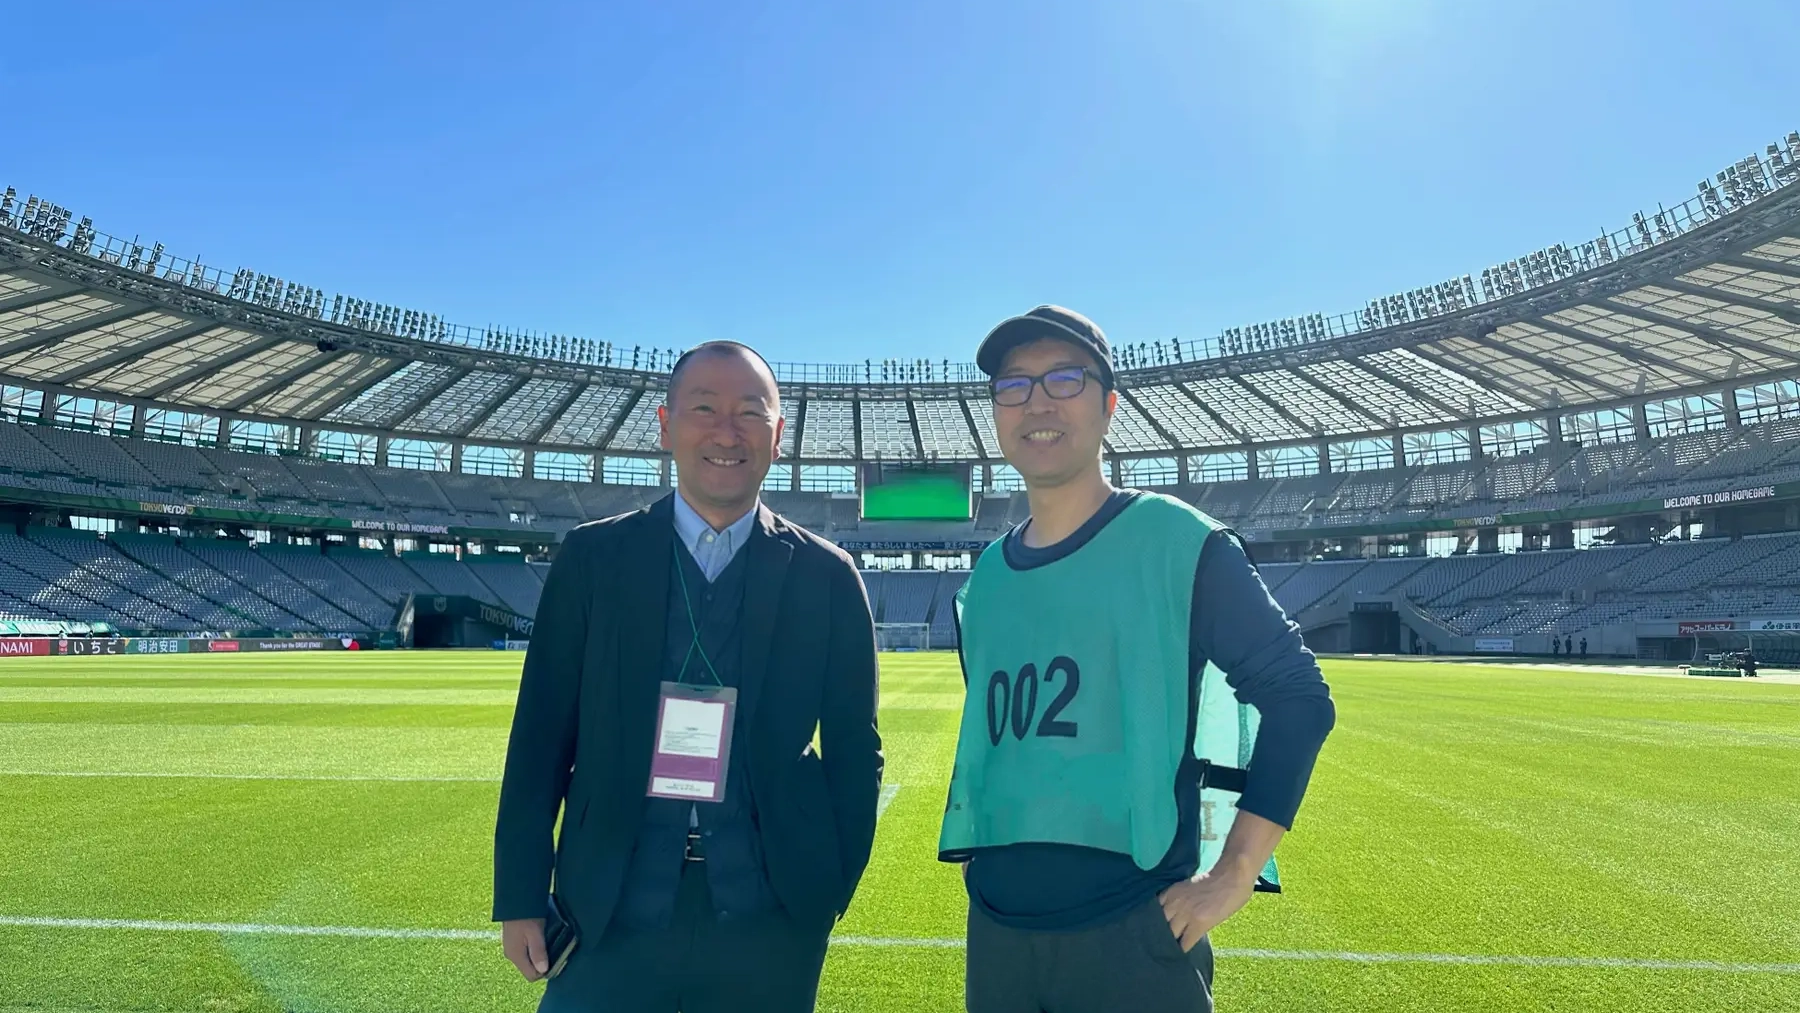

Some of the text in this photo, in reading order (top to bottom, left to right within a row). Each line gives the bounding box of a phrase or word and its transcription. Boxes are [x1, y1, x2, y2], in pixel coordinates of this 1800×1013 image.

[1663, 486, 1775, 509] WELCOME TO OUR HOMEGAME
[352, 520, 385, 531] WELCOME
[386, 522, 396, 532] TO
[396, 523, 410, 532] OUR
[0, 641, 33, 653] NAMI
[73, 640, 117, 654] いちご
[138, 640, 178, 653] 明治安田
[986, 655, 1080, 747] 002
